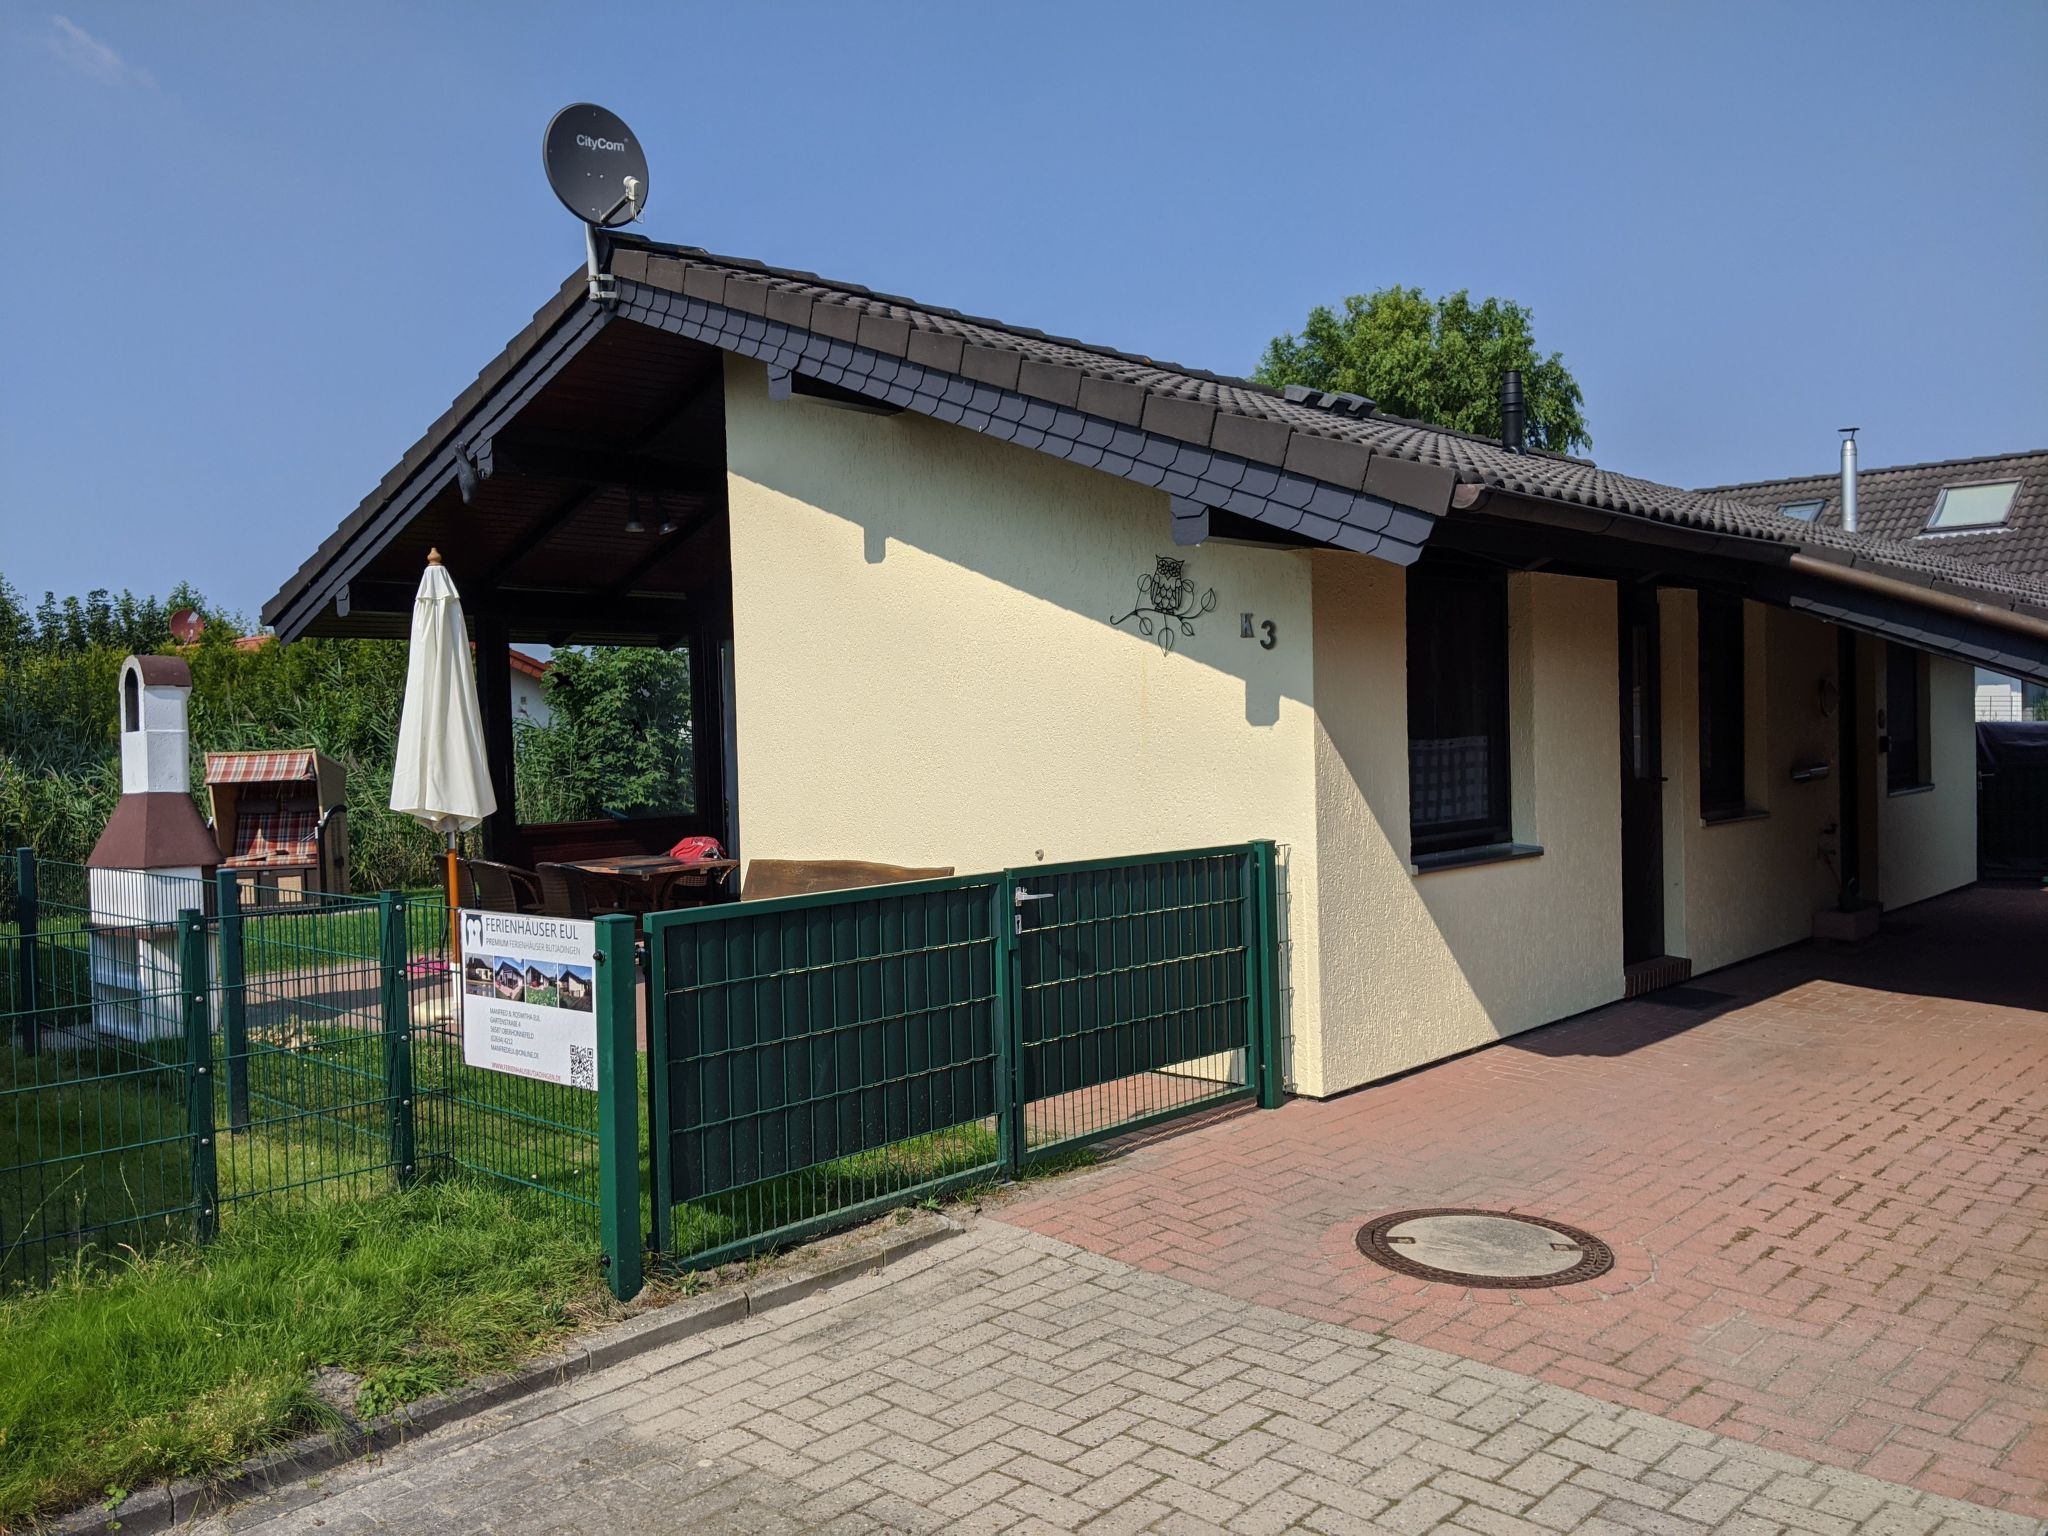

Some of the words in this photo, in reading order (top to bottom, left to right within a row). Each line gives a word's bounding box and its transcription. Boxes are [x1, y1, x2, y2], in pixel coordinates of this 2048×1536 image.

[576, 134, 625, 151] CityCom
[1260, 620, 1277, 650] 3
[485, 917, 557, 938] FERIENHÄUSER
[560, 923, 579, 940] EUL
[486, 937, 509, 948] PREMIUM
